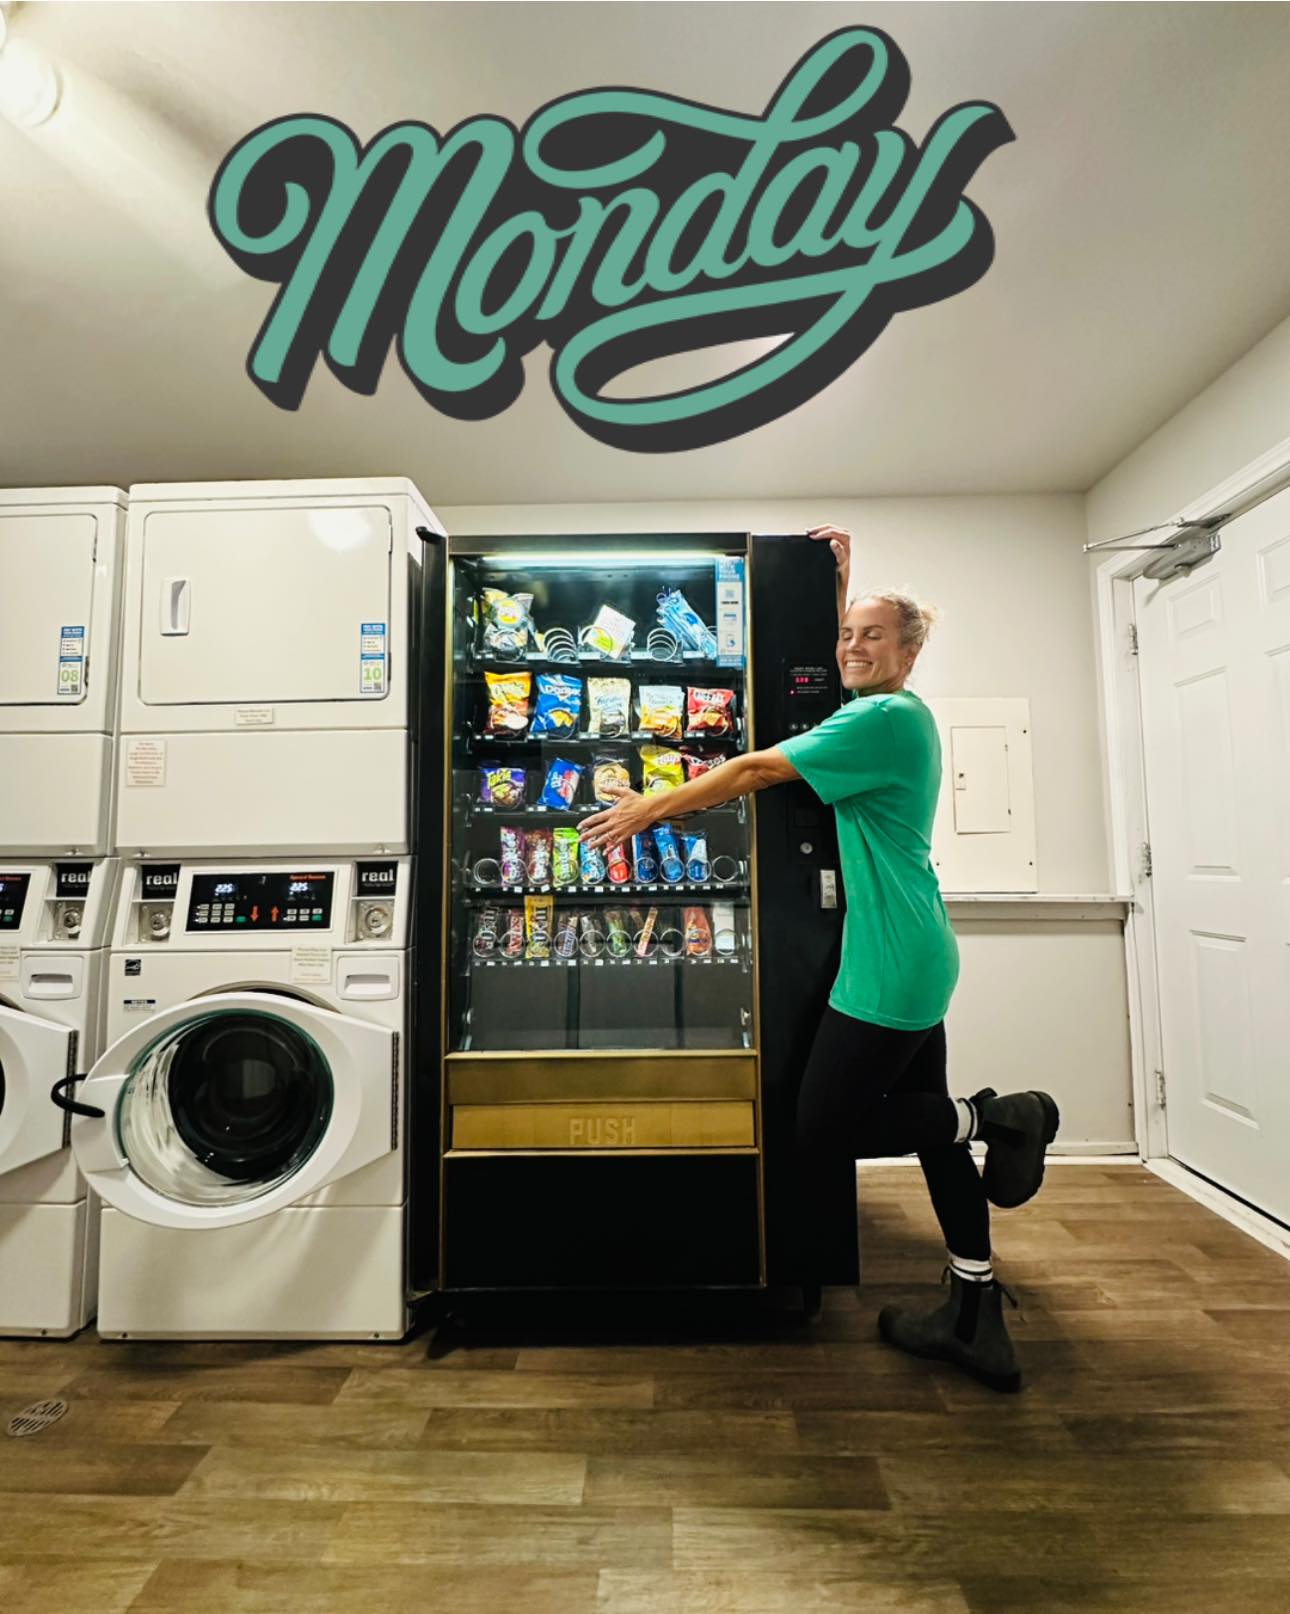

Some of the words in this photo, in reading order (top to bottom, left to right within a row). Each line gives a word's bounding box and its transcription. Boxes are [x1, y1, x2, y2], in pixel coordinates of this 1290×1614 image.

[61, 669, 79, 682] 08
[364, 667, 382, 681] 10
[146, 872, 178, 885] real
[362, 869, 394, 882] real
[569, 1117, 636, 1145] PUSH
